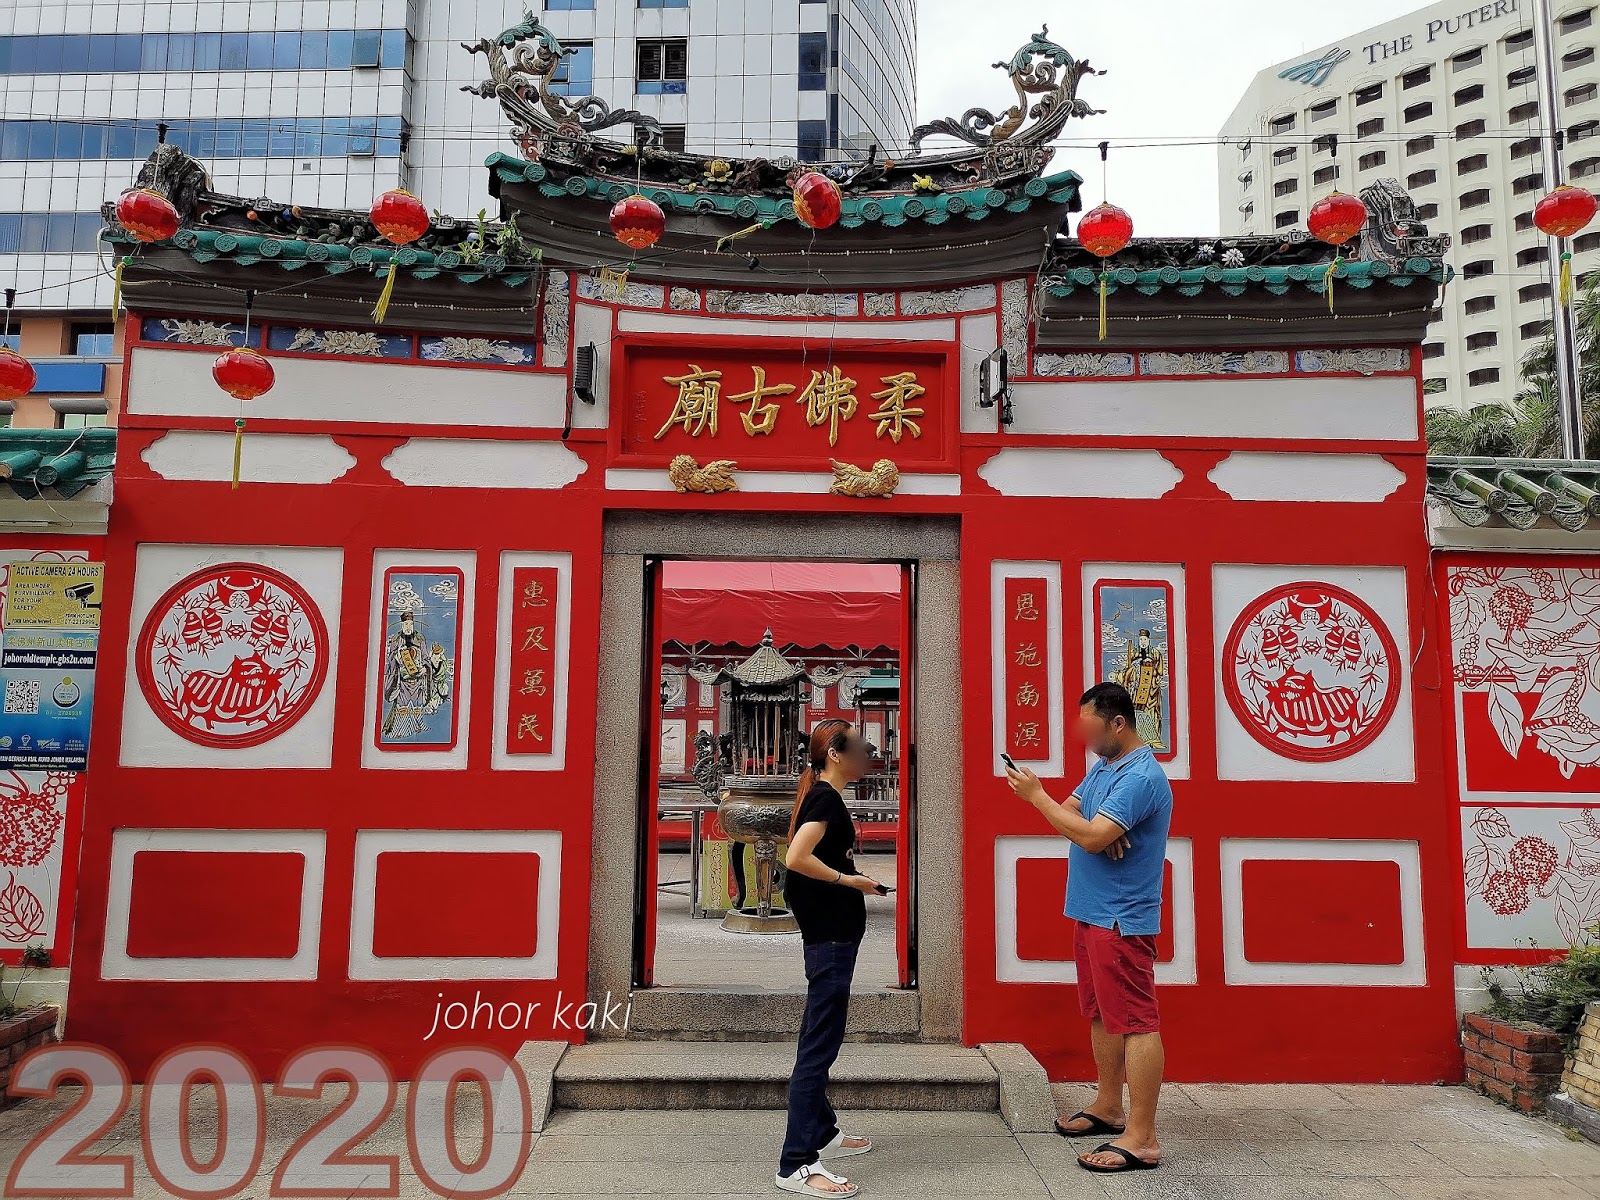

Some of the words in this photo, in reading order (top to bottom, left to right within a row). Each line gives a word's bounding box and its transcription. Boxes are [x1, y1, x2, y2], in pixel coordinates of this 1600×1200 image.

[1362, 34, 1413, 65] THE
[1426, 0, 1518, 43] PUTERI
[653, 364, 926, 448] 柔佛古廟
[16, 566, 40, 576] ACTIVE
[40, 566, 67, 577] CAMERA
[68, 567, 76, 576] 24
[77, 567, 99, 577] HOURS
[4, 652, 94, 666] johoroldtemple.gbs2u.com
